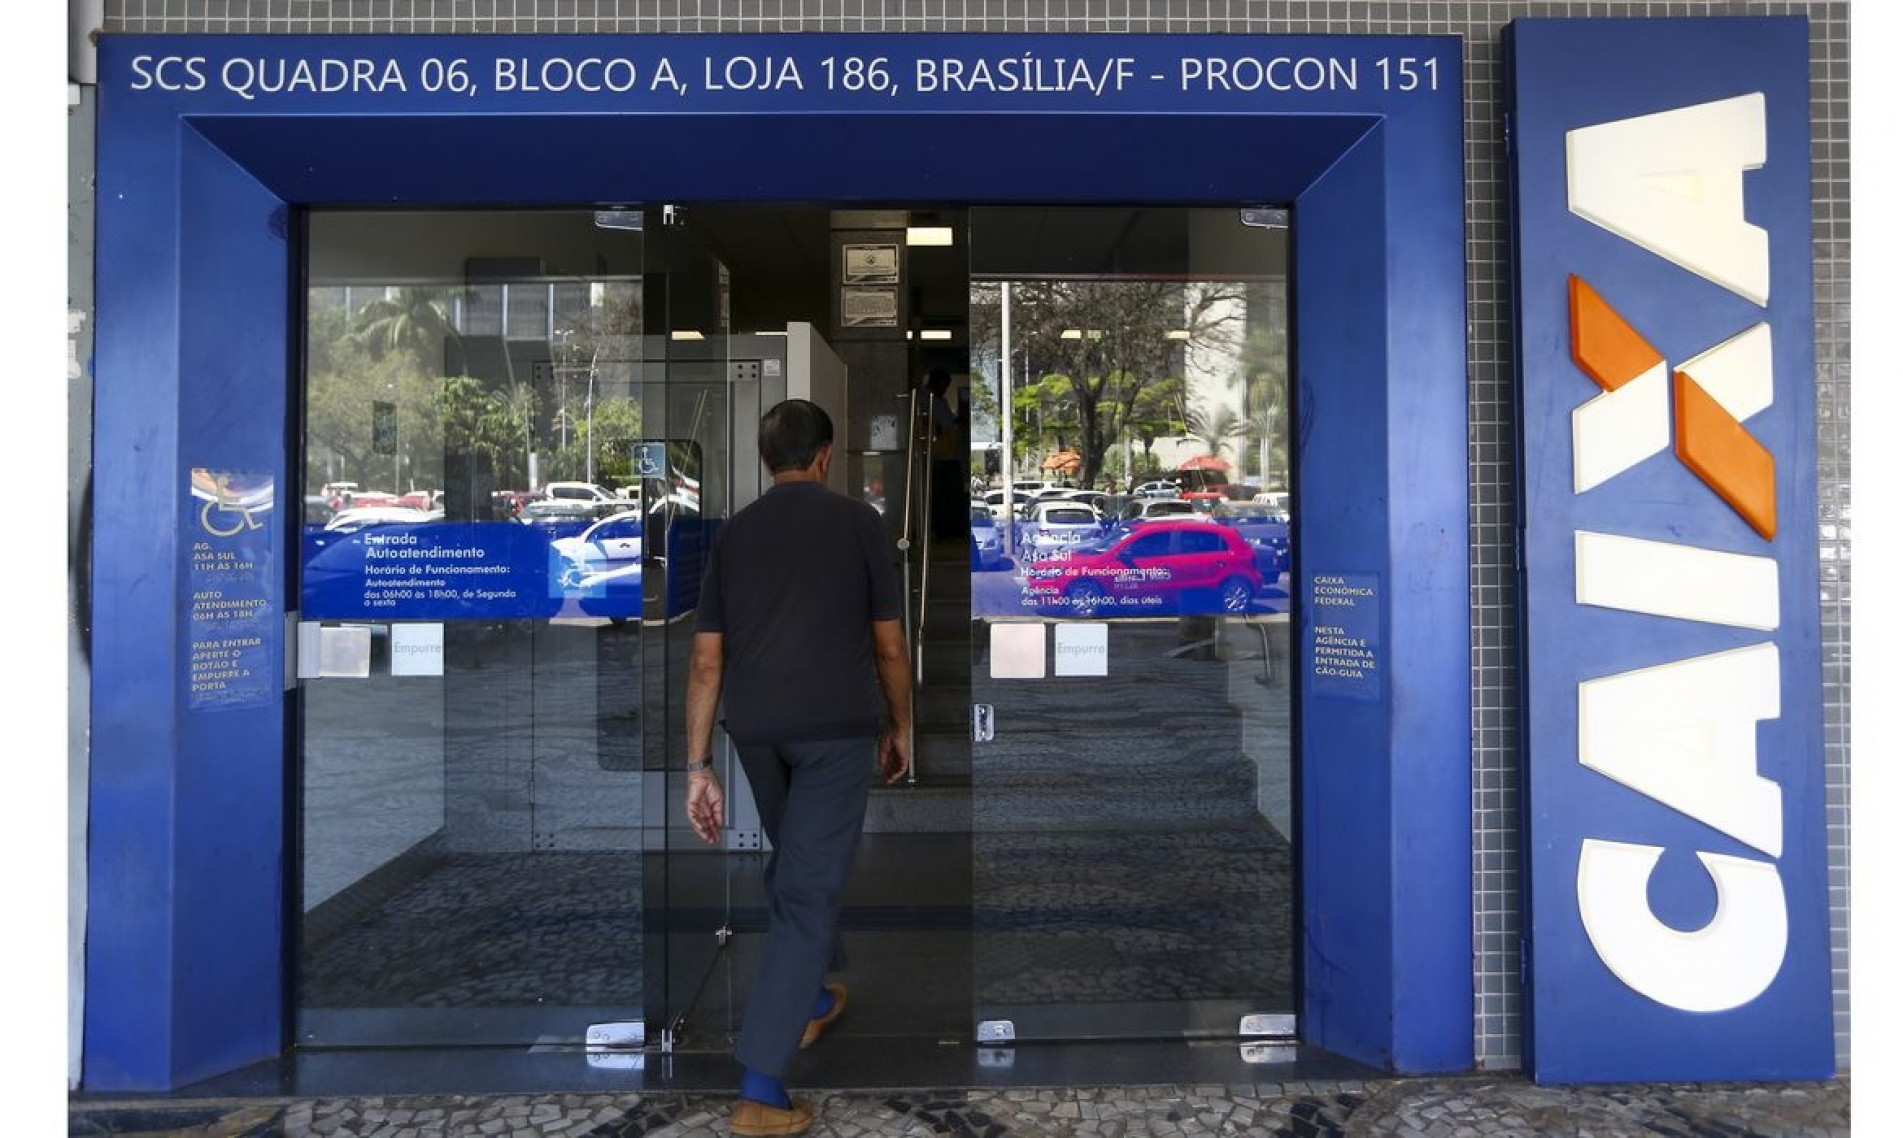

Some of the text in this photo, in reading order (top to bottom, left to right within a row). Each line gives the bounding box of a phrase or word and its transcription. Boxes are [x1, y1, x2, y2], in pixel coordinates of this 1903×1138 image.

[132, 56, 206, 91] SCS
[222, 57, 408, 100] QUADRA
[420, 57, 477, 97] 06,
[495, 57, 637, 92] BLOCO
[650, 58, 688, 97] A,
[705, 57, 804, 91] LOJA
[820, 57, 899, 97] 186,
[916, 51, 1135, 97] BRASÍLIA/F
[1181, 57, 1357, 91] PROCON
[1375, 57, 1437, 91] 151
[364, 533, 418, 545] Entrada
[194, 552, 236, 560] ASA SUL
[365, 546, 486, 559] Autoatendimento
[1567, 91, 1788, 1013] CAIXA
[365, 564, 512, 575] Horário de Funcionamento:
[1065, 565, 1079, 577] de
[1314, 576, 1345, 585] CAIXA
[193, 591, 222, 600] AUTO
[364, 589, 381, 599] das
[462, 589, 475, 599] de
[193, 599, 266, 610] ATENDIMENTO
[1021, 596, 1039, 606] das
[1314, 596, 1356, 607] FEDERAL
[1315, 626, 1345, 635] NESTA
[193, 637, 262, 650] PARA ENTRAR
[394, 641, 442, 656] Empurre
[193, 649, 242, 660] APERTE O
[1315, 646, 1374, 658] PERMITIDA A
[1315, 656, 1376, 669] ENTRADA DE
[192, 681, 227, 692] PORTA
